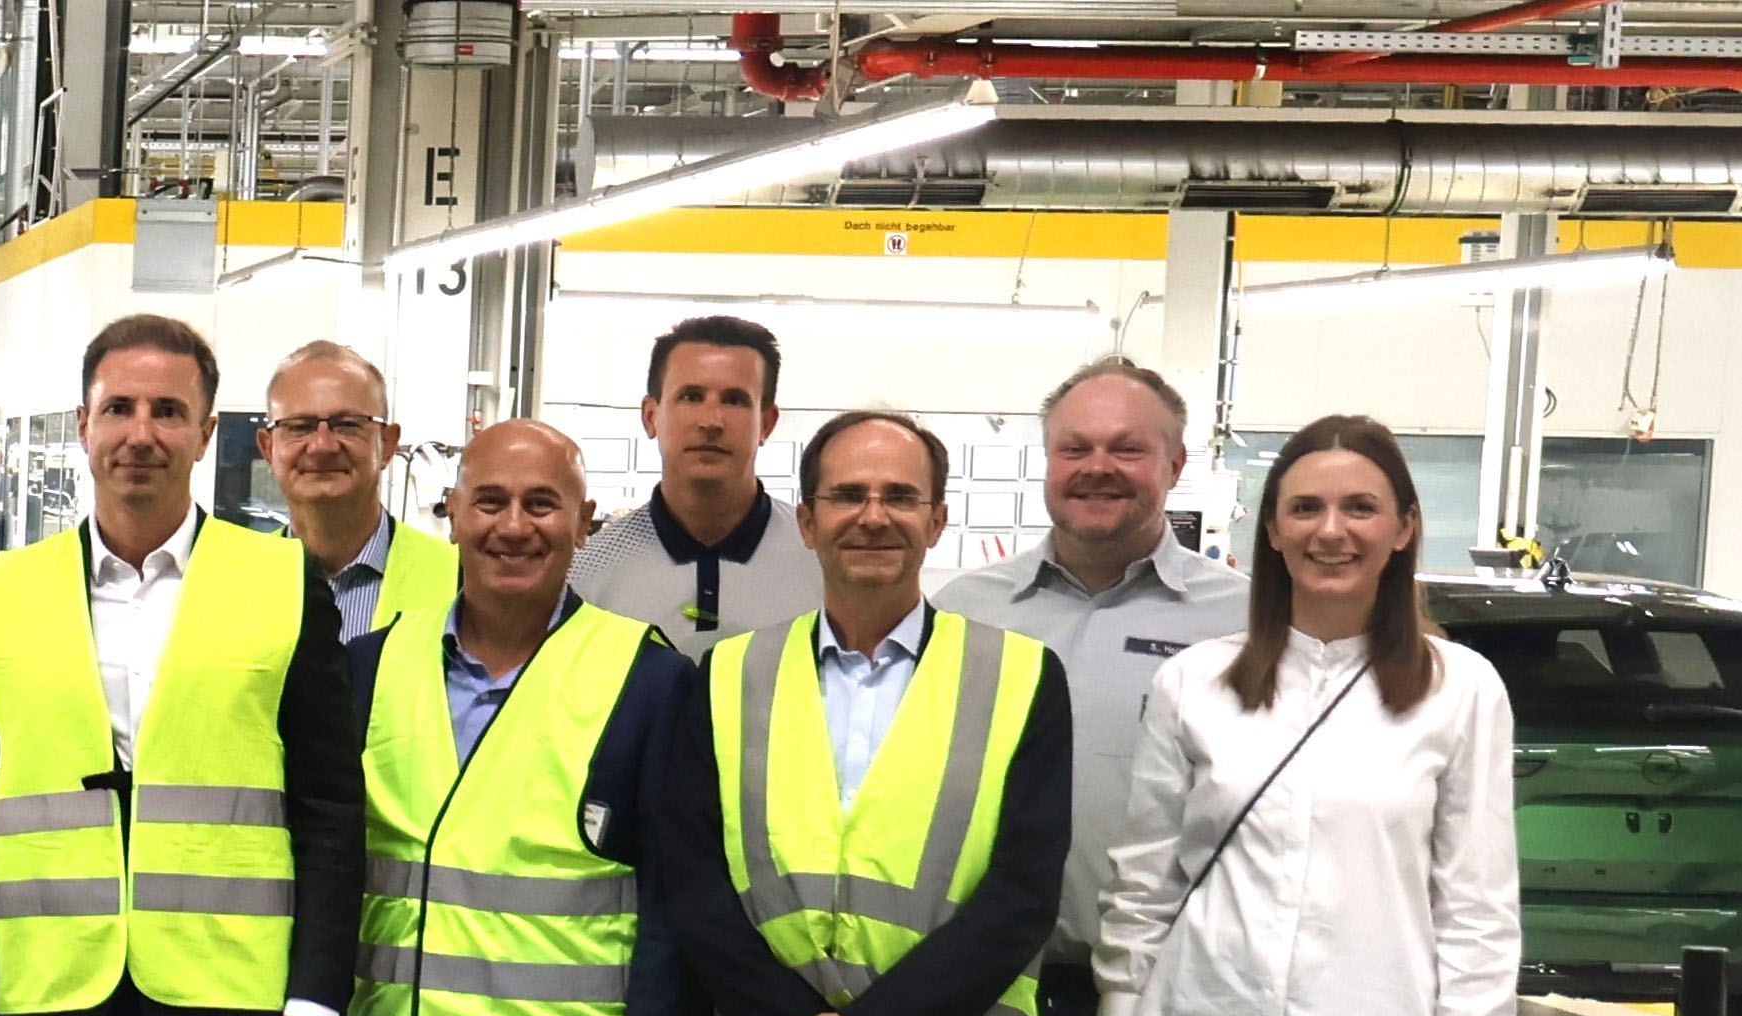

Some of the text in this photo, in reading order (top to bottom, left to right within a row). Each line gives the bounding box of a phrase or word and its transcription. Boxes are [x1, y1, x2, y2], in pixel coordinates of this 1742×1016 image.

[425, 147, 460, 205] E
[844, 220, 955, 233] Dach nicht begehbar
